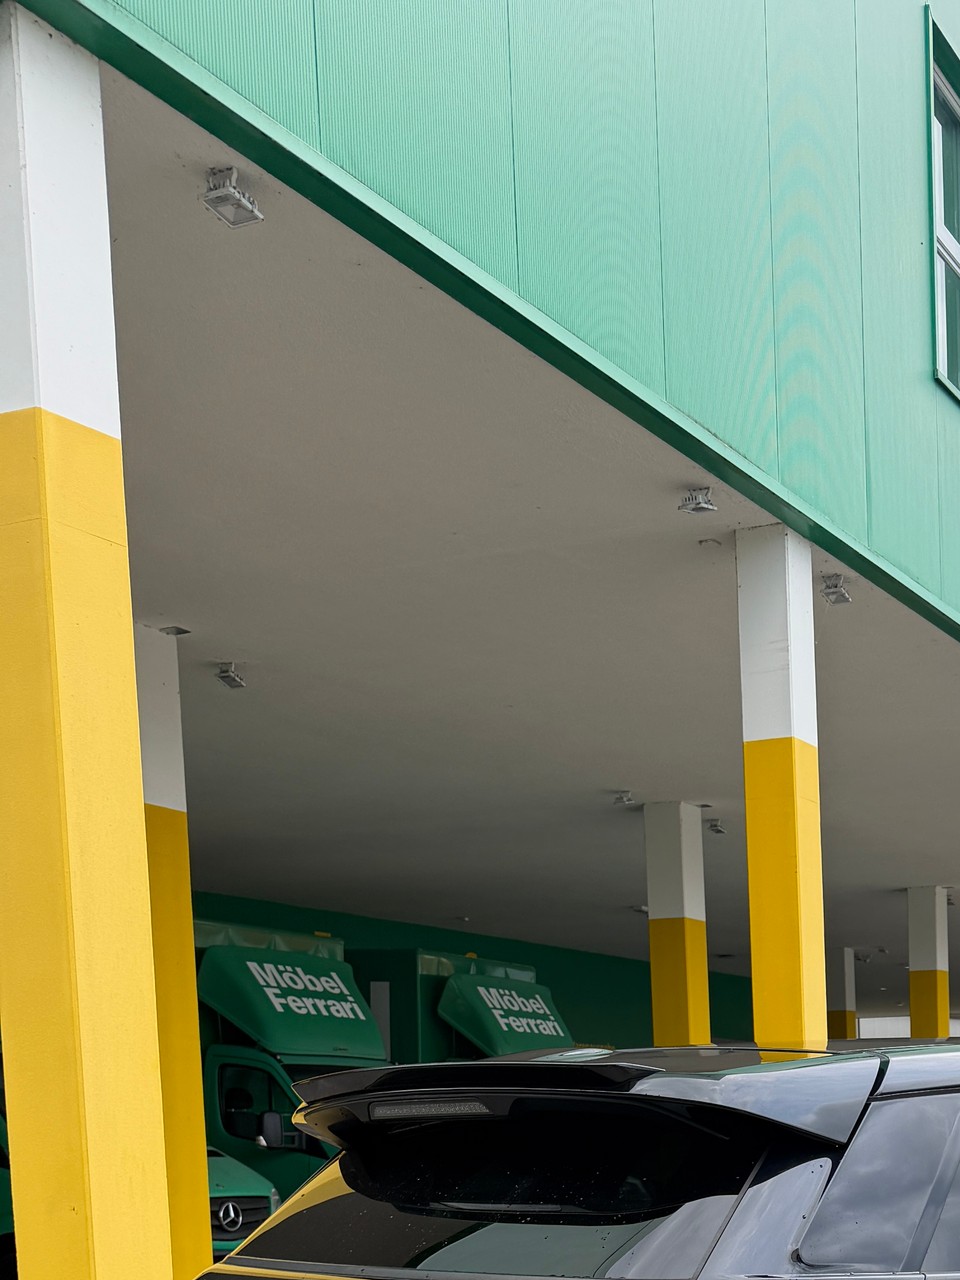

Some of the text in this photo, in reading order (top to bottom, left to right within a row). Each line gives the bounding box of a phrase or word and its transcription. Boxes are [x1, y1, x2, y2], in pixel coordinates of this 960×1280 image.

[246, 961, 351, 995] Möbel
[263, 986, 367, 1020] Ferrari
[477, 986, 552, 1015] Möbel
[491, 1008, 565, 1037] Ferrari
